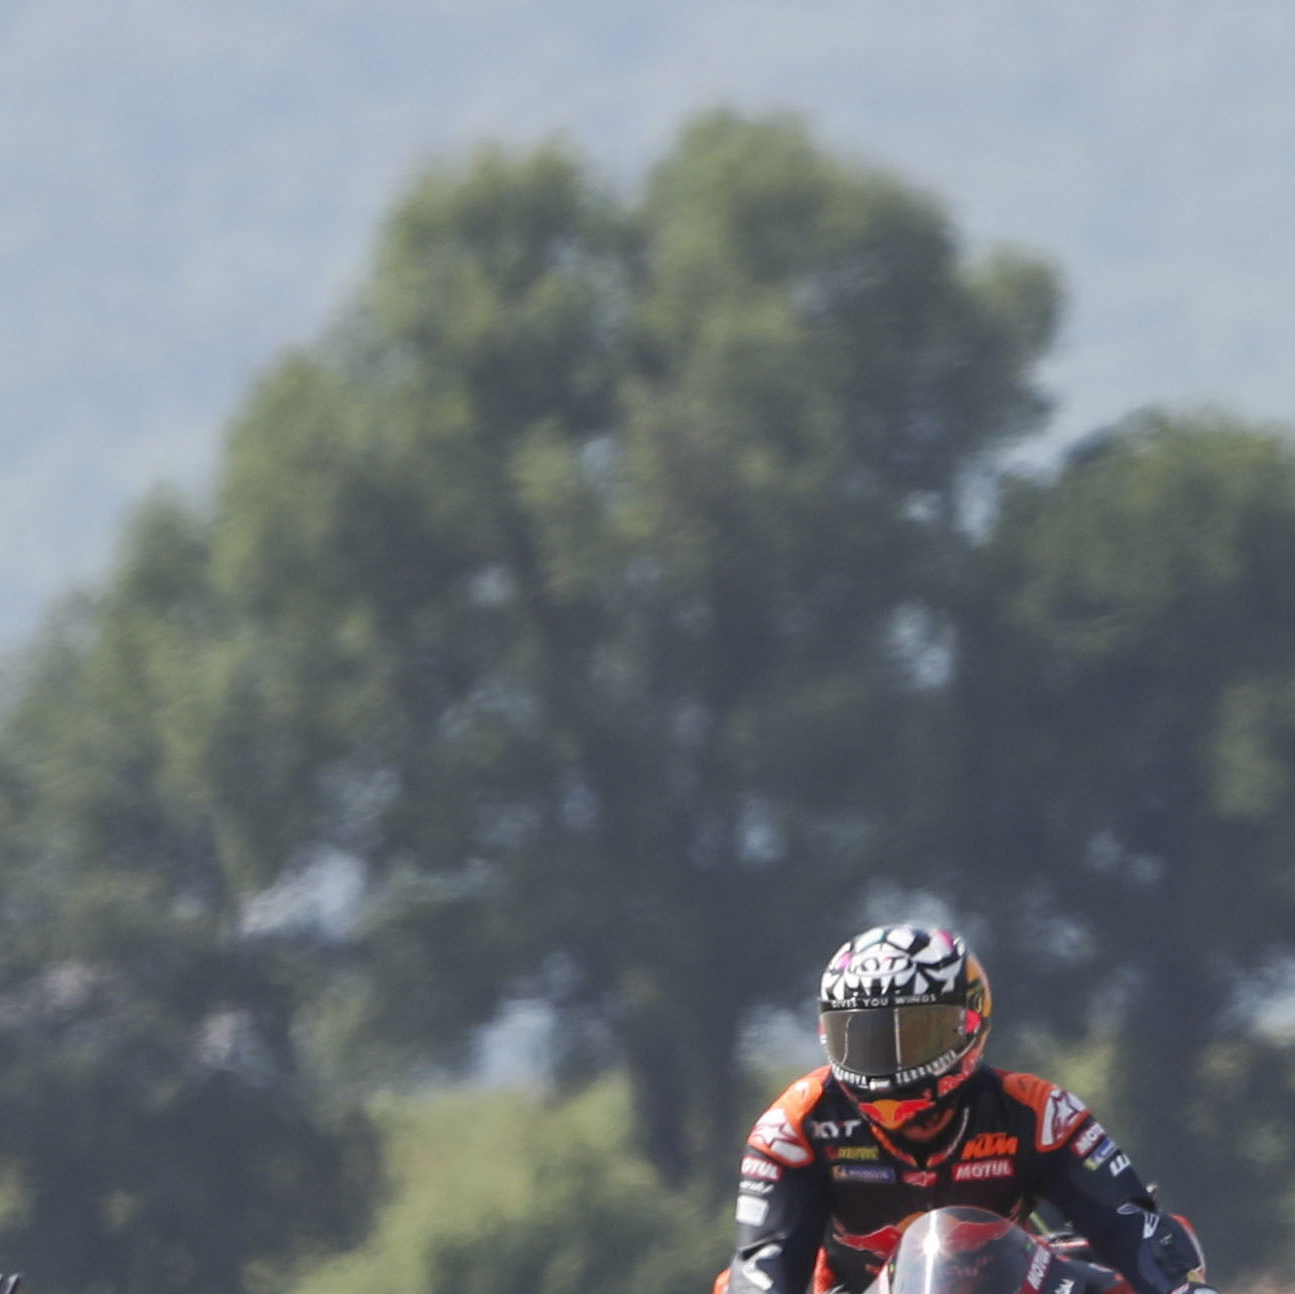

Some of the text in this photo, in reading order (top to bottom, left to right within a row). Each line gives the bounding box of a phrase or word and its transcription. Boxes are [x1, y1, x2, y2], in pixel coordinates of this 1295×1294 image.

[832, 997, 857, 1008] GIVES
[863, 997, 888, 1007] YOU
[962, 1133, 1018, 1159] KTM
[955, 1160, 1011, 1181] MOTUL
